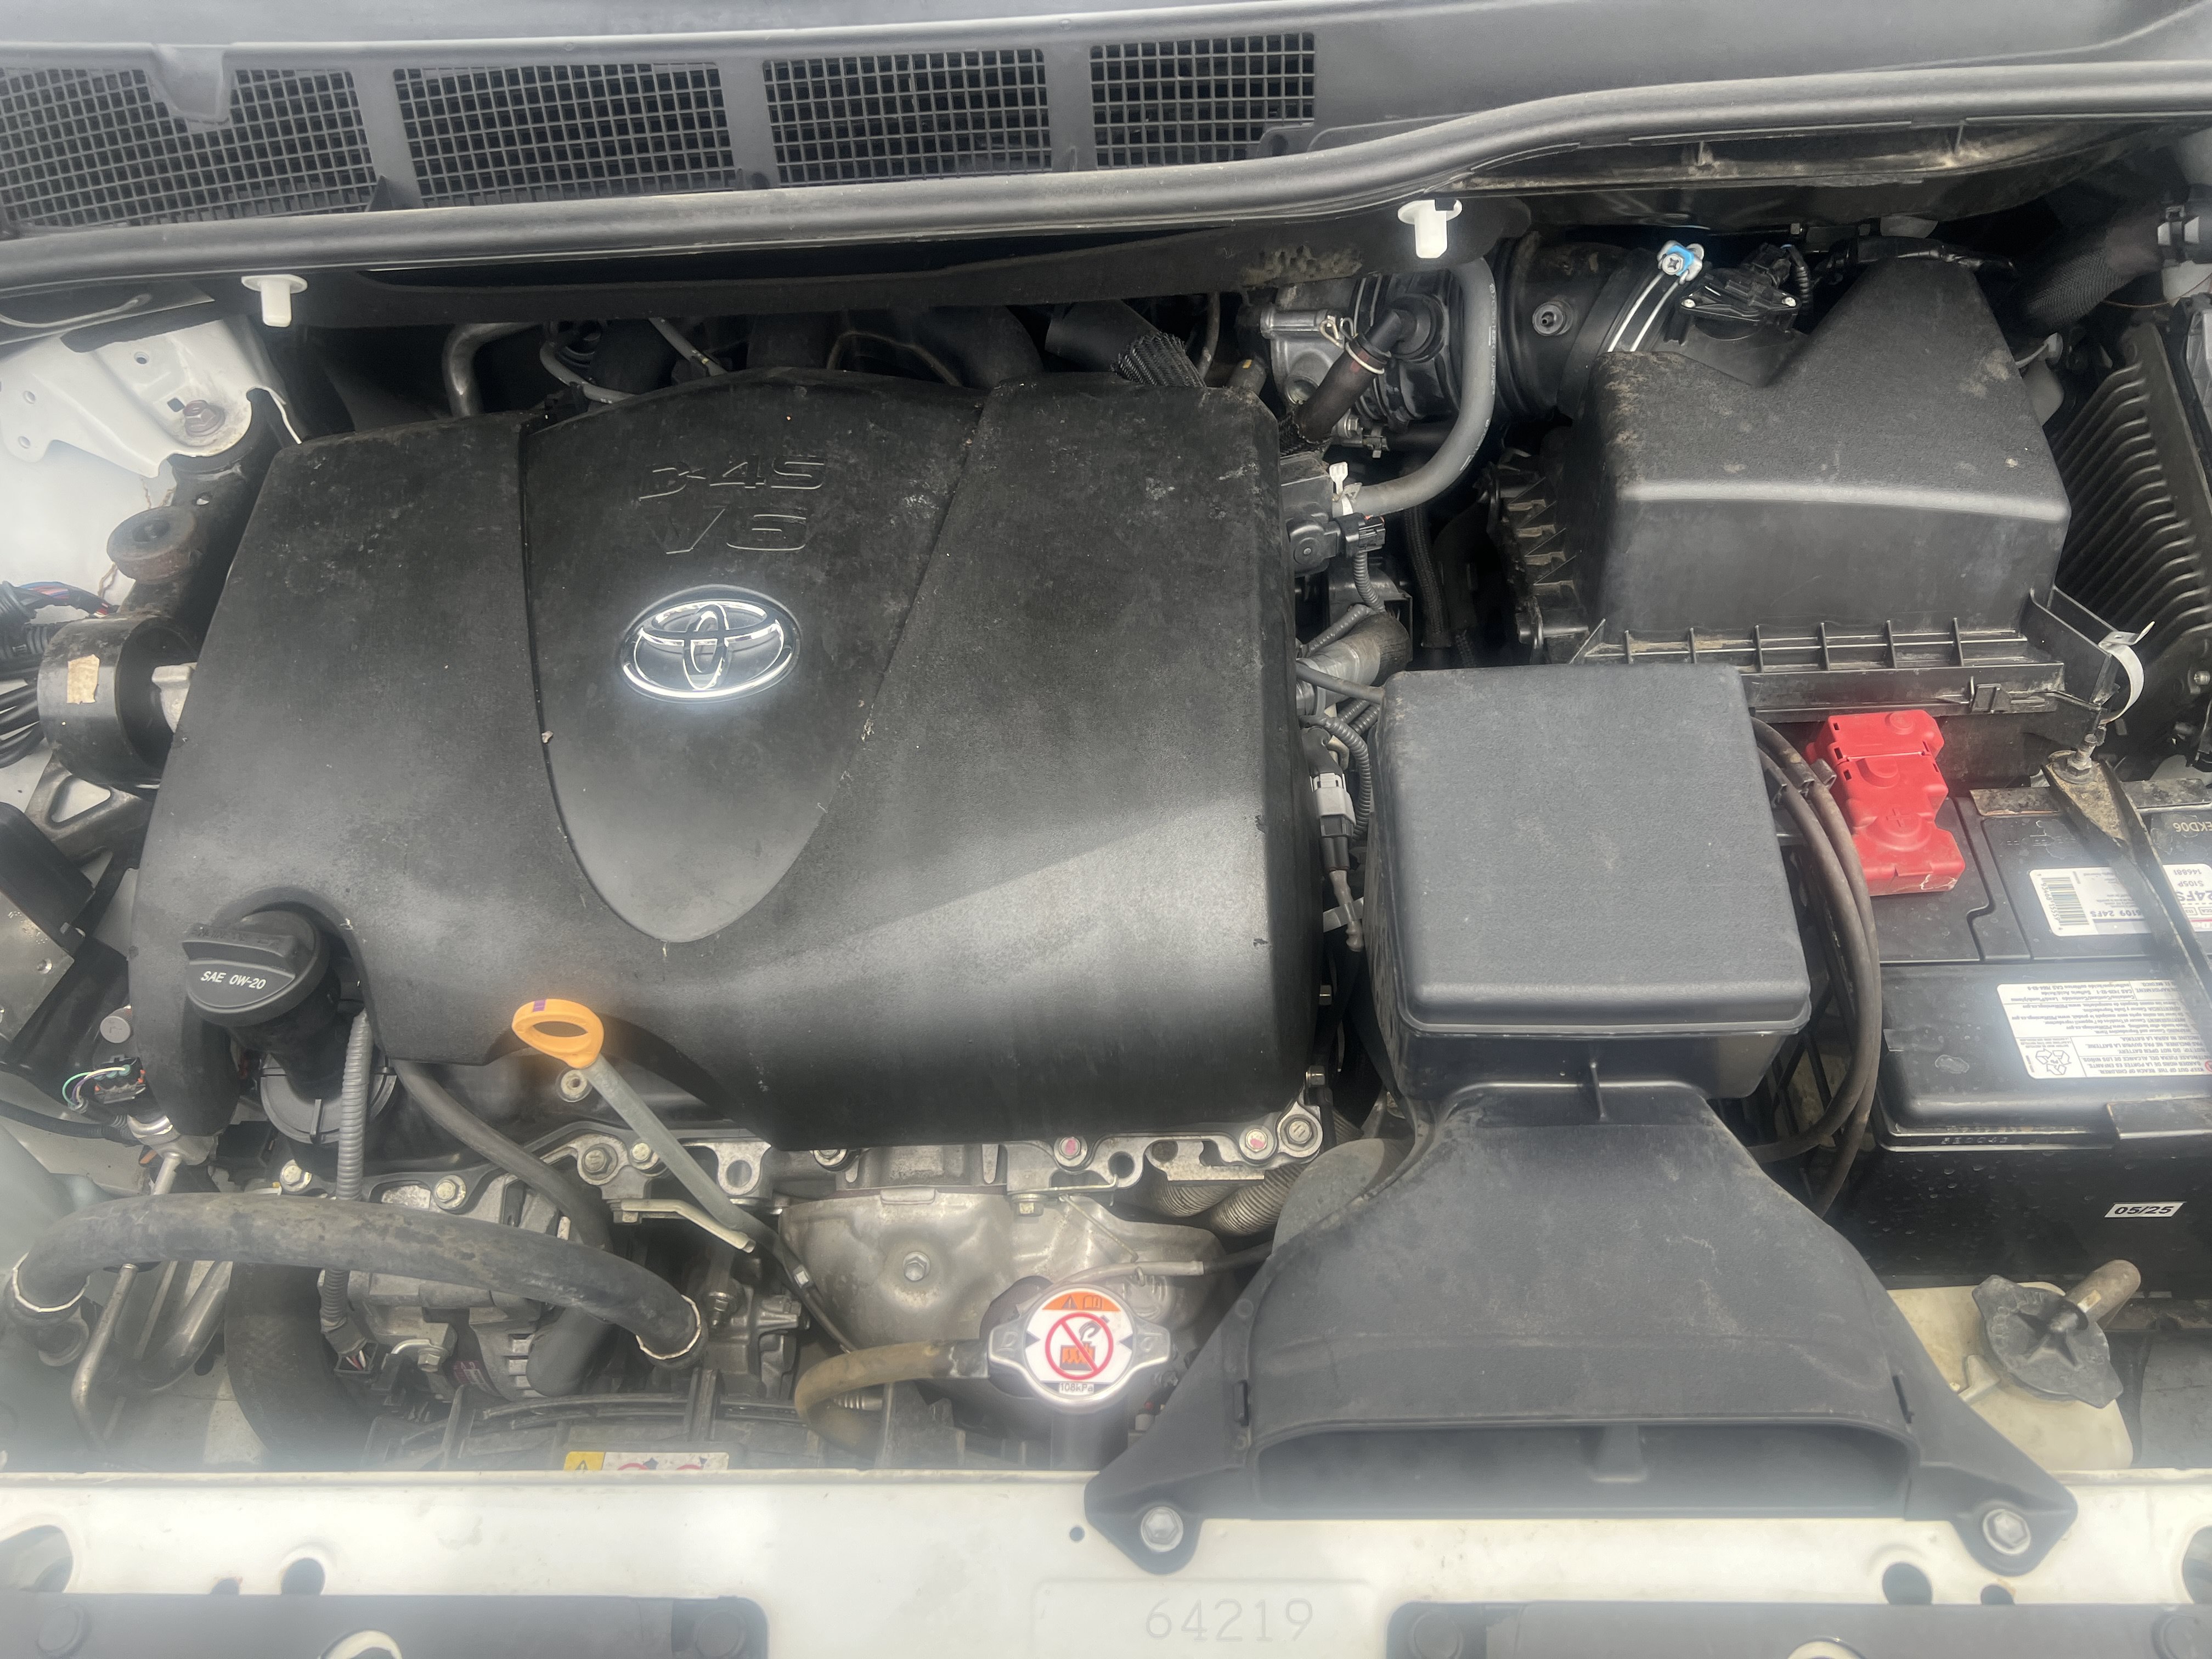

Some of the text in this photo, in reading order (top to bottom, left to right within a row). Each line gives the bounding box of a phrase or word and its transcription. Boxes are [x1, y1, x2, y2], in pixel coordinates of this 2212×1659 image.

[638, 455, 827, 500] D-4S
[650, 505, 809, 554] V6
[201, 970, 267, 990] SAE 0W-20
[2115, 1206, 2174, 1215] 05/25
[1059, 1383, 1094, 1393] 108kPa
[1146, 1597, 1313, 1642] 64219
